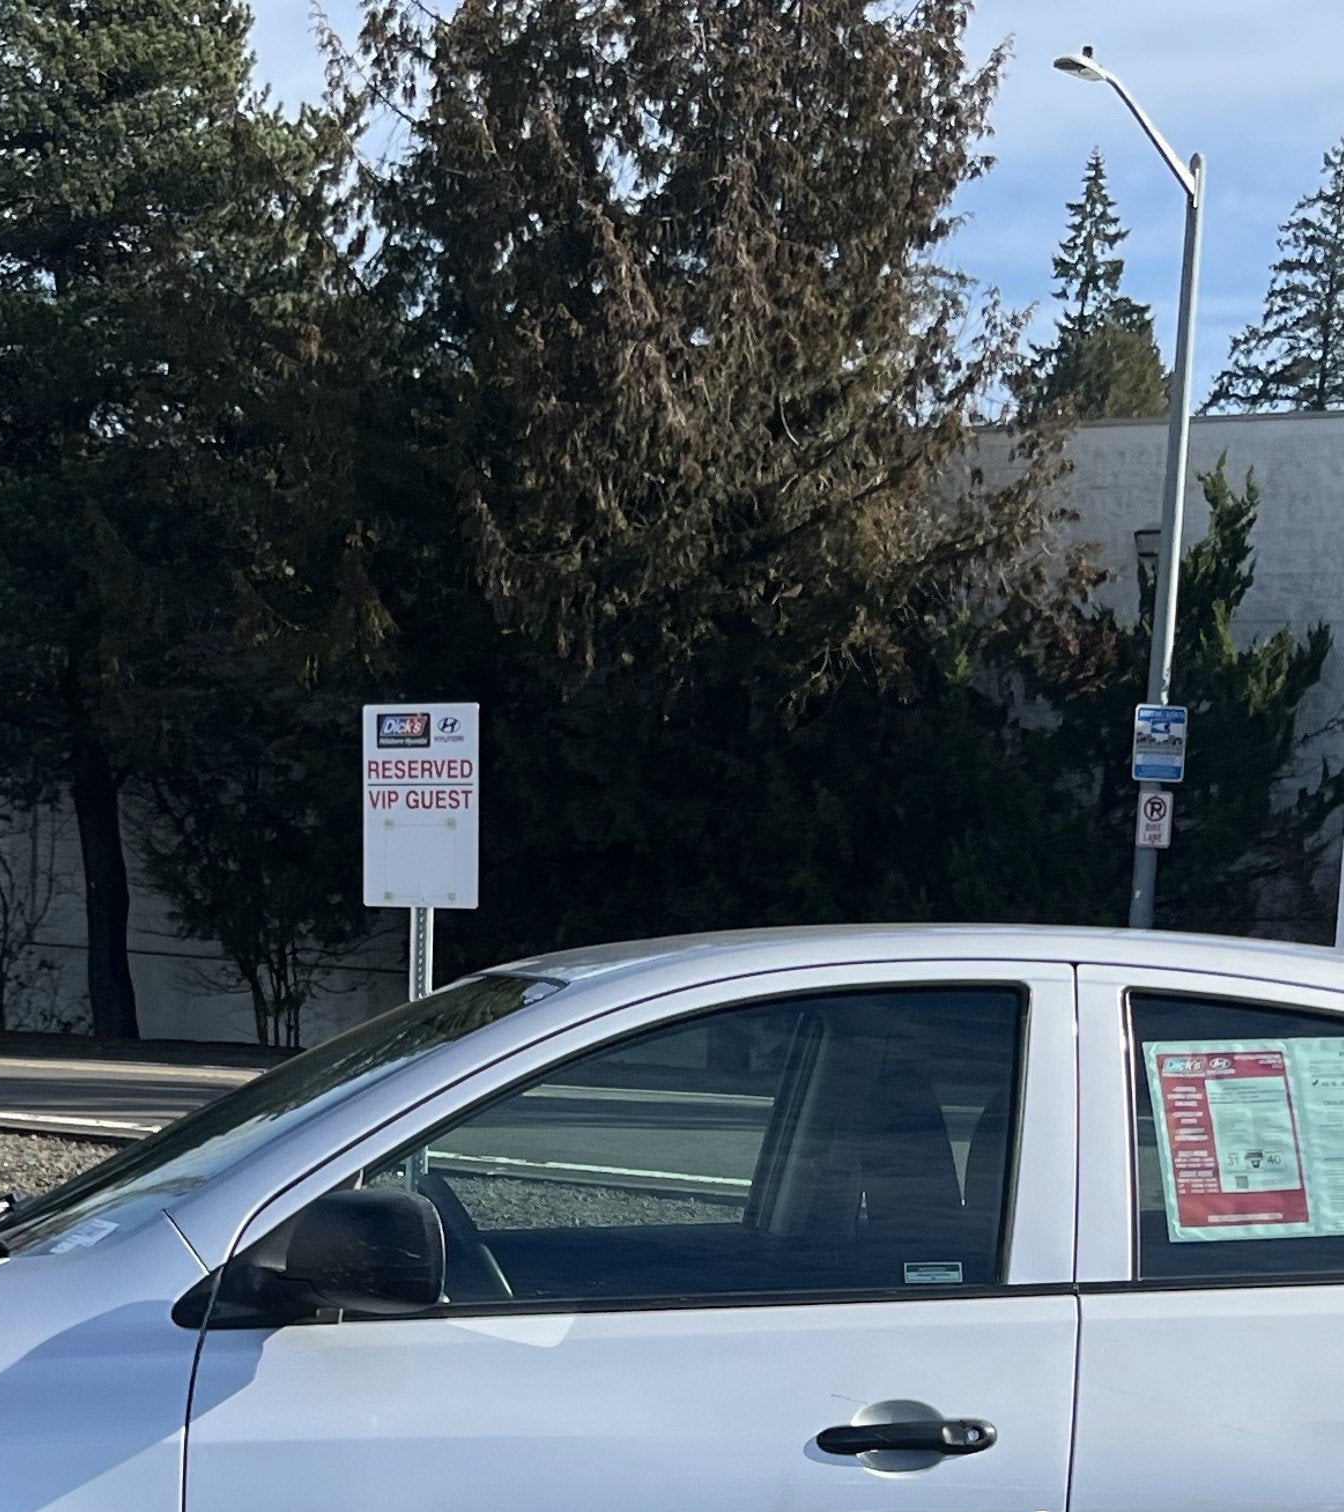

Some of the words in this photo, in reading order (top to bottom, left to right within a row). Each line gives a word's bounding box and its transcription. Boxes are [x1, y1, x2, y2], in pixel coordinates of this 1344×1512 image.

[367, 759, 473, 780] RESERVED
[368, 790, 399, 809] VIP
[405, 790, 473, 809] GUEST
